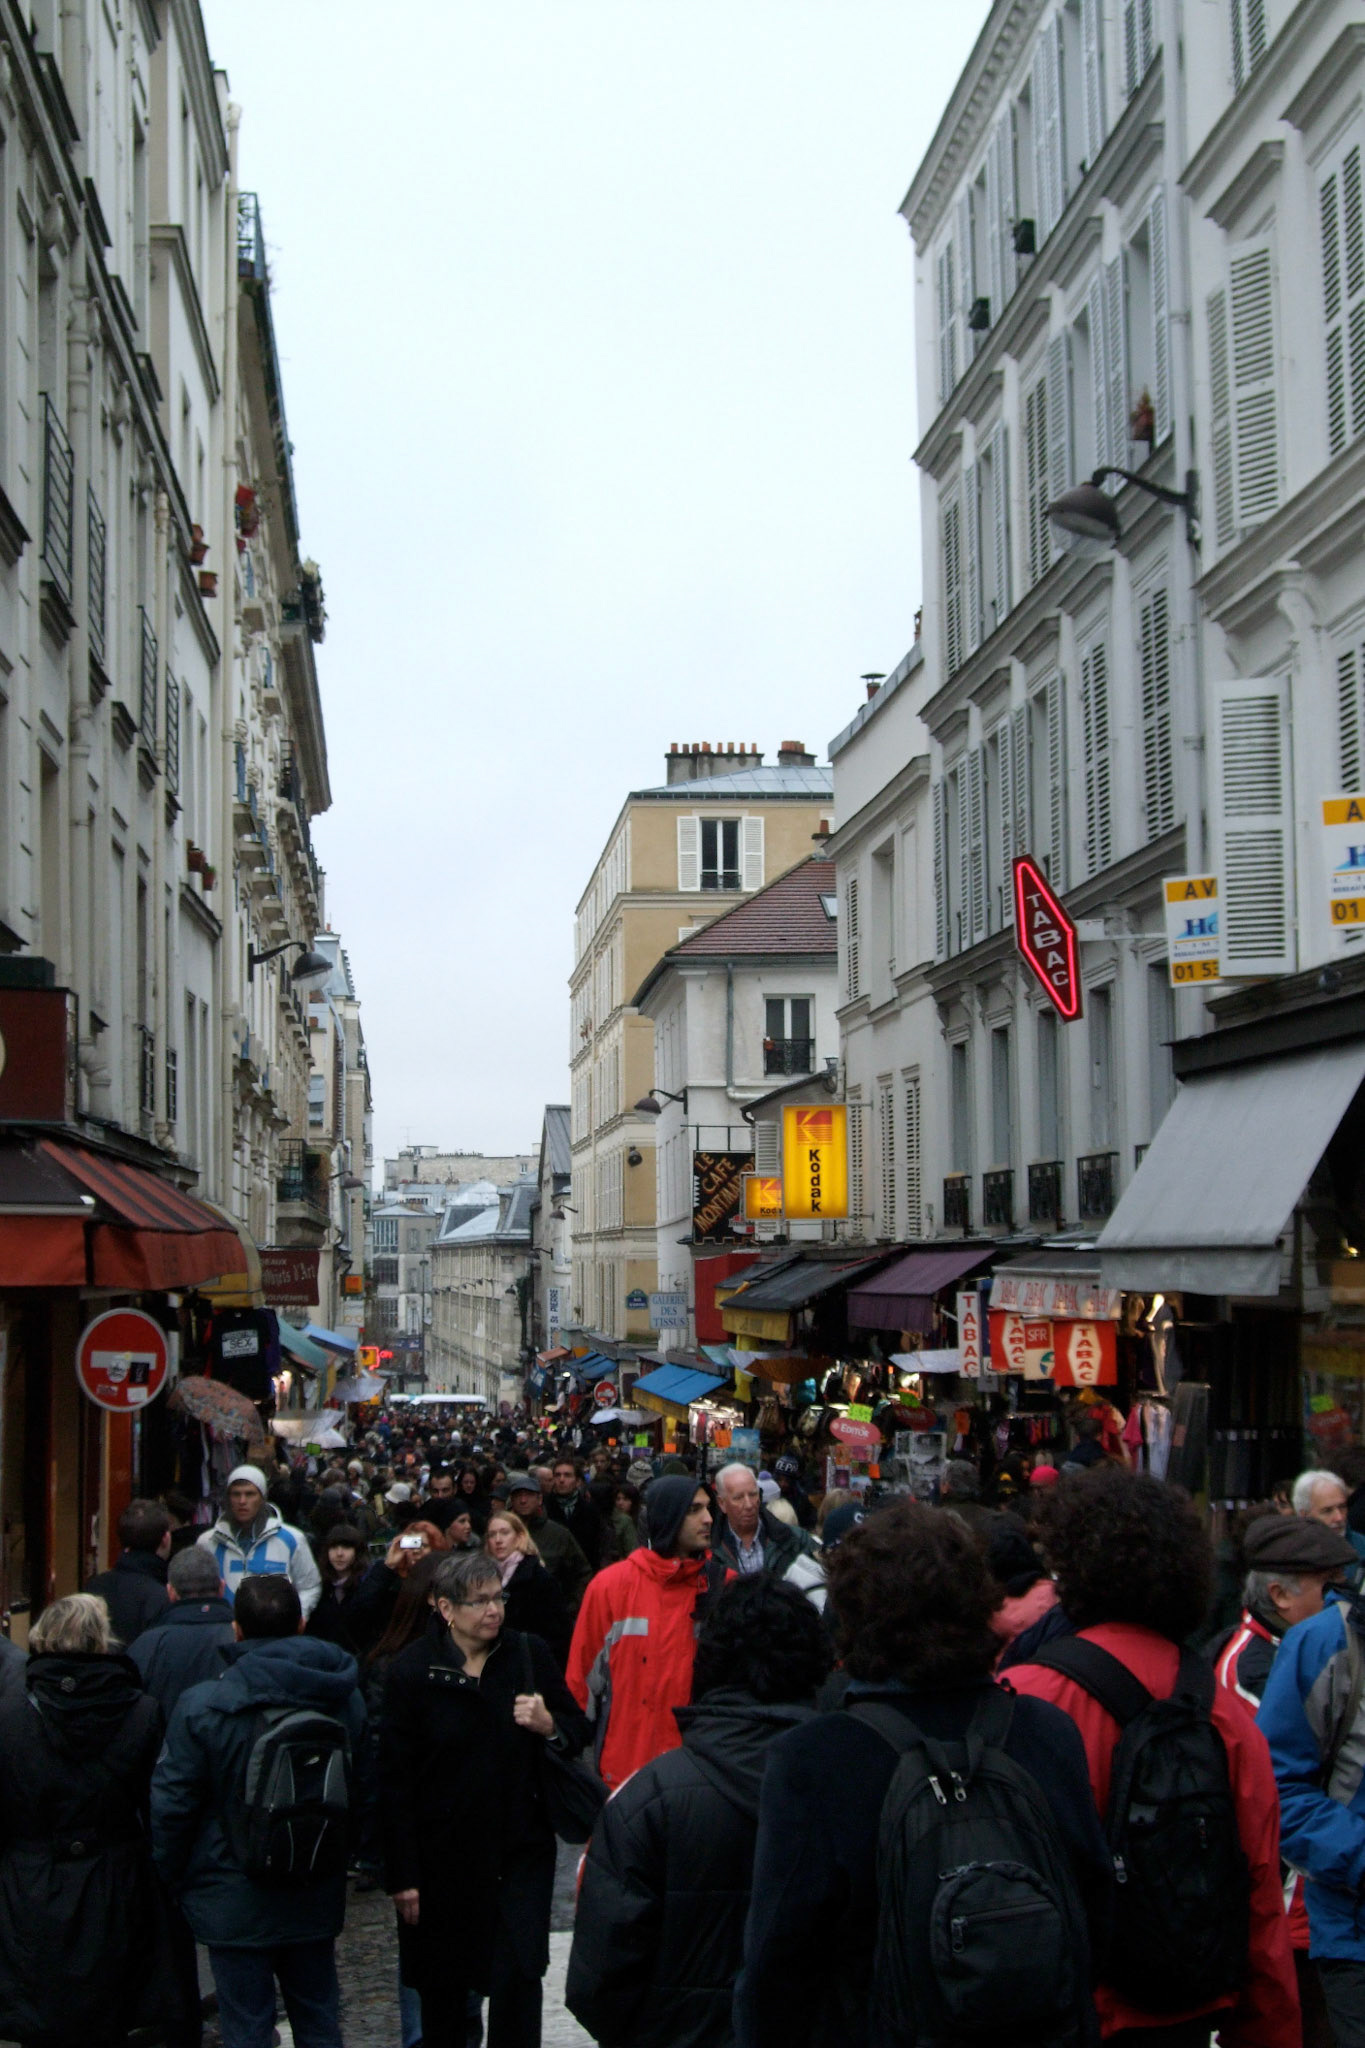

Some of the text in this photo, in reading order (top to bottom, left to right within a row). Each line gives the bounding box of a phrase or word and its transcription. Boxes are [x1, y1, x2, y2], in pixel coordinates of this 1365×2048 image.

[1026, 893, 1069, 986] TABAC
[695, 1153, 714, 1172] LE
[809, 1149, 821, 1213] Kodak
[652, 1295, 685, 1305] GALERIES
[660, 1306, 677, 1316] DES
[653, 1317, 686, 1327] TISSUS
[962, 1295, 978, 1375] TABAC
[1028, 1328, 1048, 1342] SFR
[1008, 1317, 1024, 1364] TABAC
[1076, 1328, 1094, 1381] TABAC
